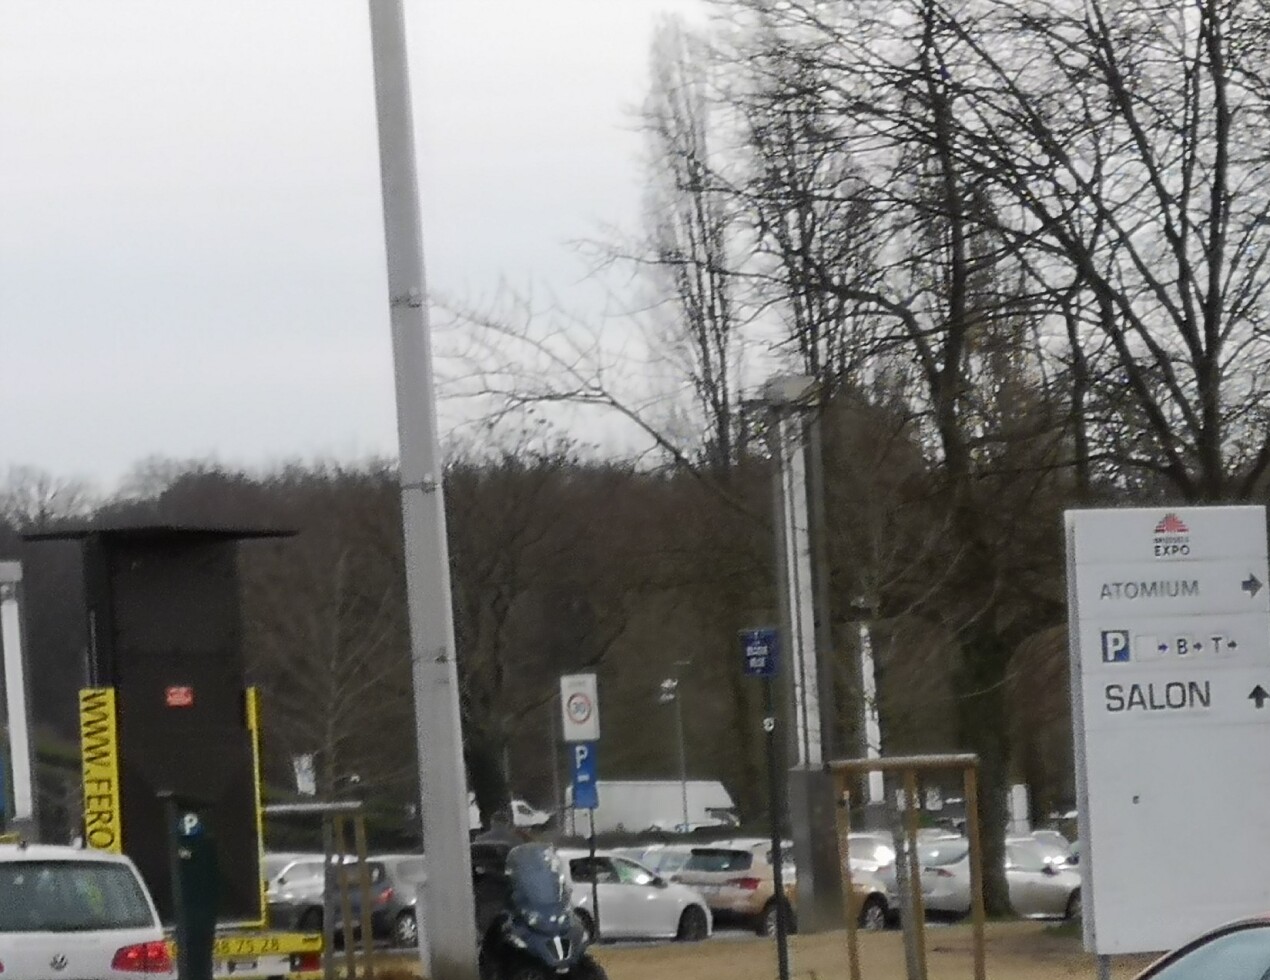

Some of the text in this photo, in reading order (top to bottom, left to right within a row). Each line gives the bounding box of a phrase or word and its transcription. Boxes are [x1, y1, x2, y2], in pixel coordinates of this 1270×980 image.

[1154, 545, 1190, 556] EXPO
[1101, 580, 1199, 600] ATOMIUM
[1106, 632, 1222, 661] P B T
[1105, 681, 1211, 712] SALON
[575, 745, 588, 769] P
[184, 813, 198, 835] P
